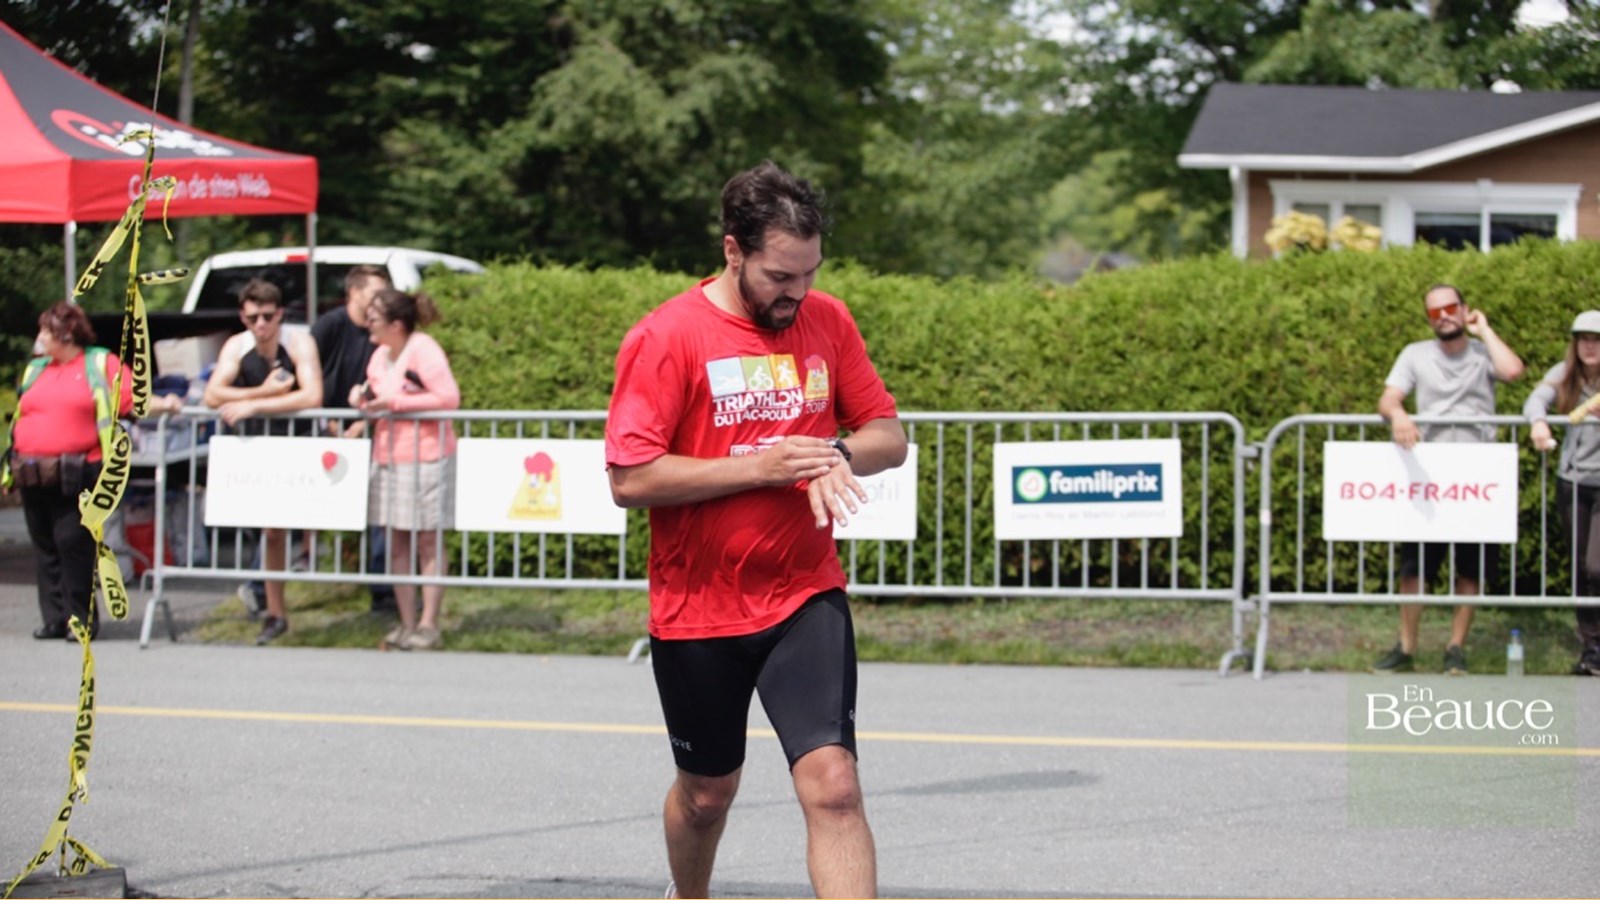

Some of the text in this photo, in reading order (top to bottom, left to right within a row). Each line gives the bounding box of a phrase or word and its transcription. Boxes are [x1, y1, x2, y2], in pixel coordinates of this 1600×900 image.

[712, 386, 804, 414] TRIATHLON
[714, 413, 734, 428] DU
[1049, 470, 1159, 498] familiprix
